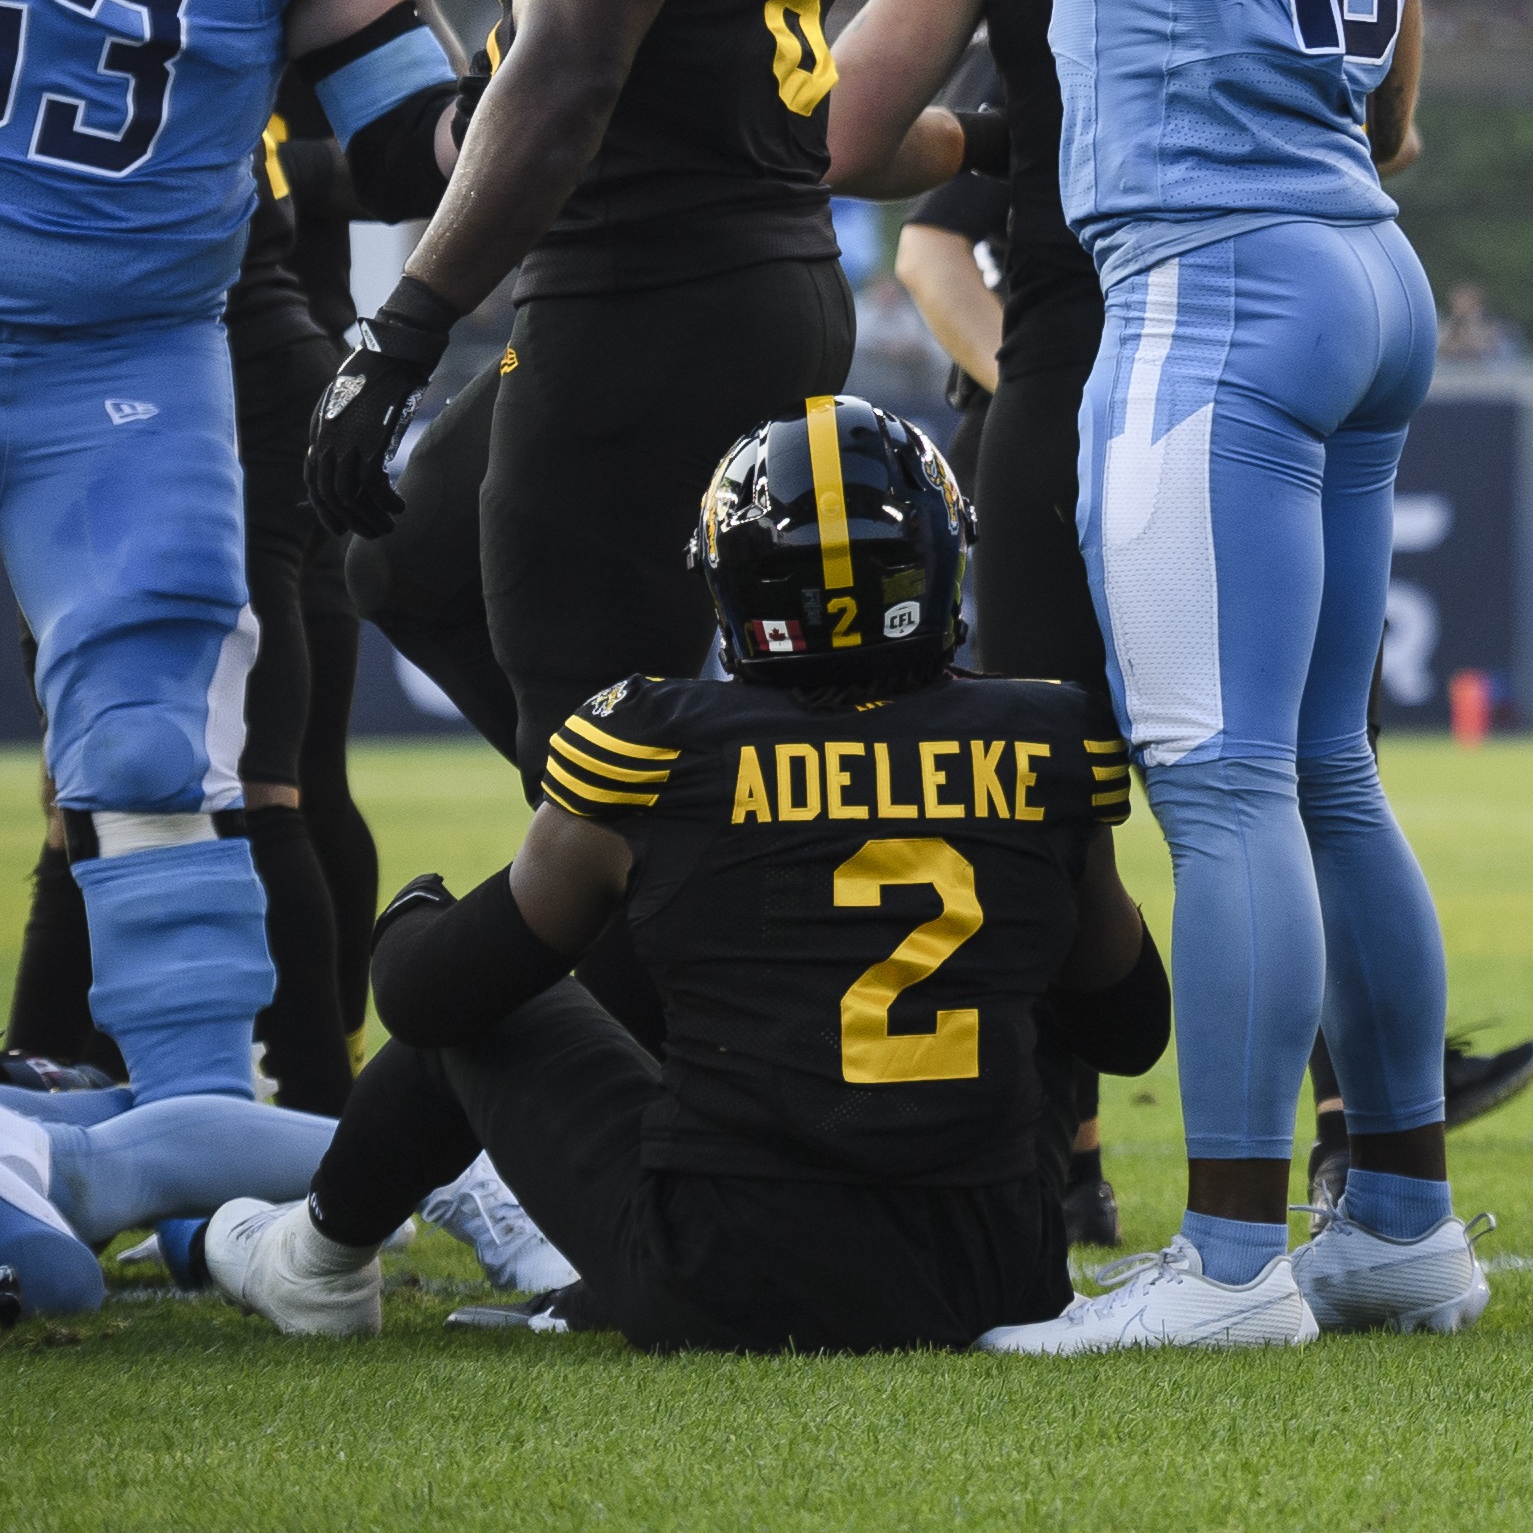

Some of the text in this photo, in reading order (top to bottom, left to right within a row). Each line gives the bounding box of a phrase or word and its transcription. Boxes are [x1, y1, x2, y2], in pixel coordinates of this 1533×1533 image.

[827, 596, 862, 649] 2
[888, 610, 916, 630] CFL
[731, 740, 1052, 825] ADELEKE
[833, 838, 984, 1083] 2
